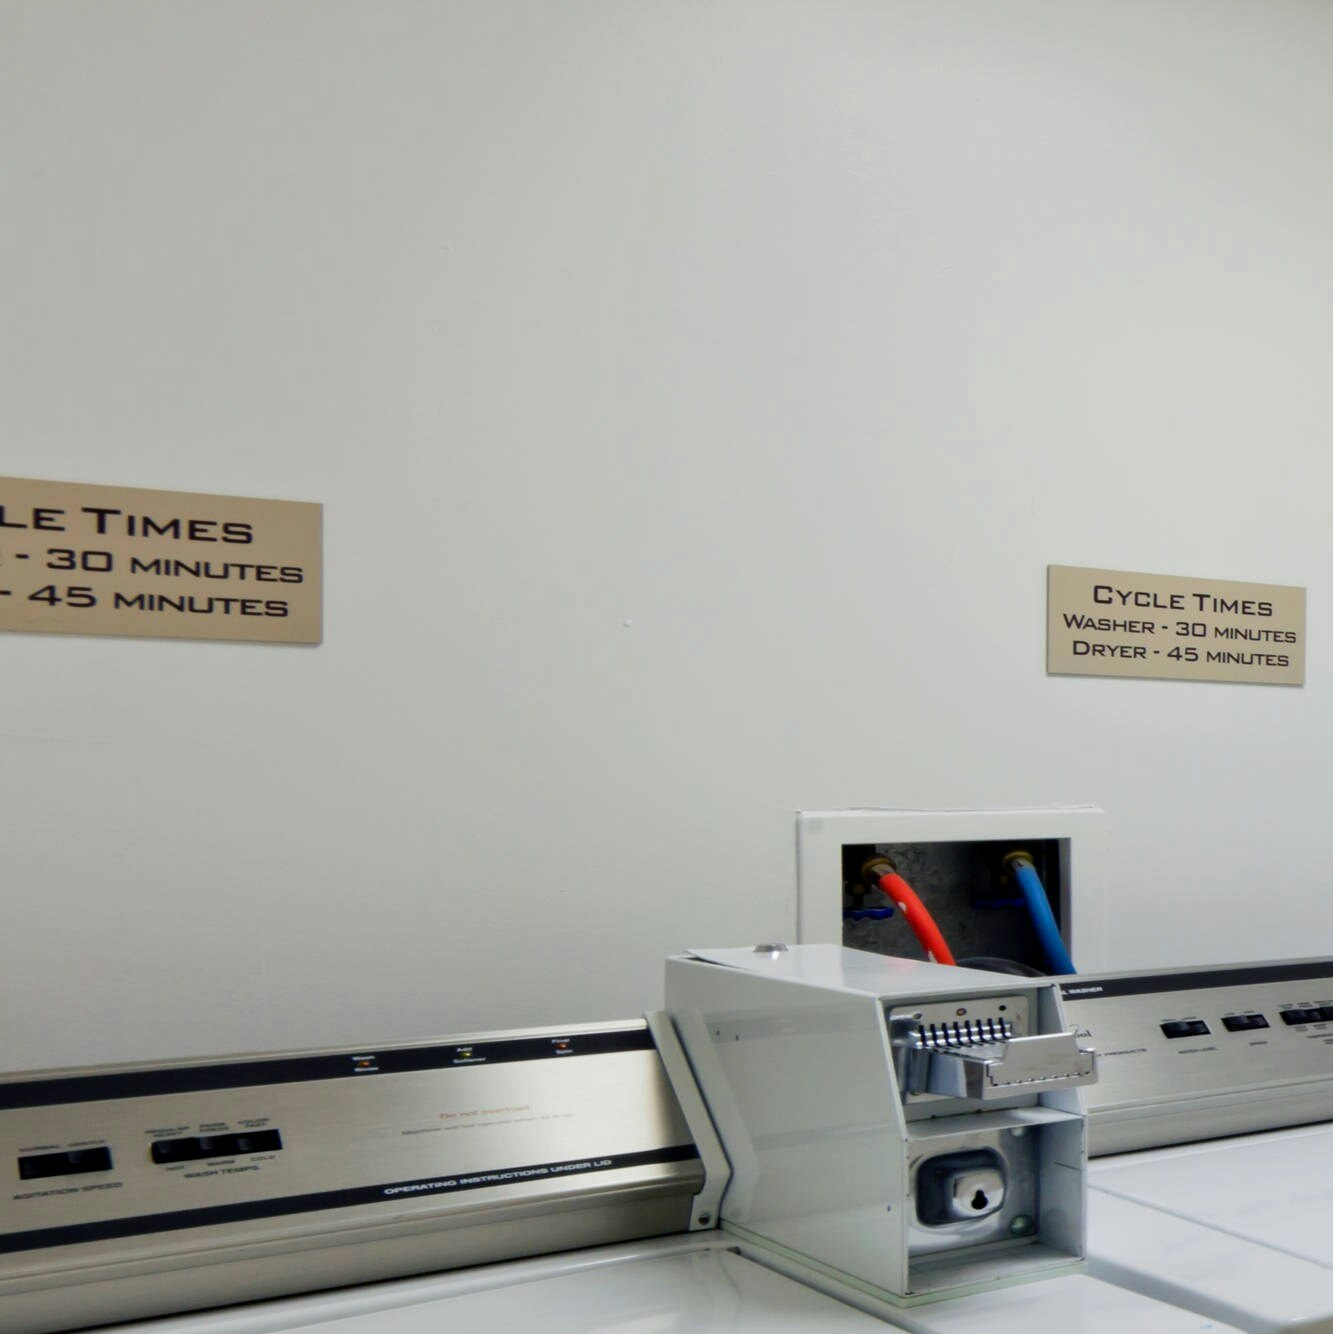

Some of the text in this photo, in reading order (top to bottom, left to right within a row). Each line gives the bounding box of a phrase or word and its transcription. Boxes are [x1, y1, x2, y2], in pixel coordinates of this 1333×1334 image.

[81, 506, 254, 545] TIMES
[46, 547, 114, 573] 30
[130, 556, 304, 584] MINUTES
[27, 585, 97, 608] 45
[113, 592, 289, 618] MINUTES
[1093, 585, 1274, 617] CYCLE TIMES
[1063, 613, 1156, 635] WASHER
[1175, 621, 1207, 638] 30
[1214, 626, 1297, 644] MINUTES
[1072, 639, 1147, 660] DRYER
[1167, 646, 1199, 662] 45
[1206, 650, 1290, 667] MINUTES
[383, 1159, 613, 1196] OPERATING INSTRUCTIONS UNDER LID
